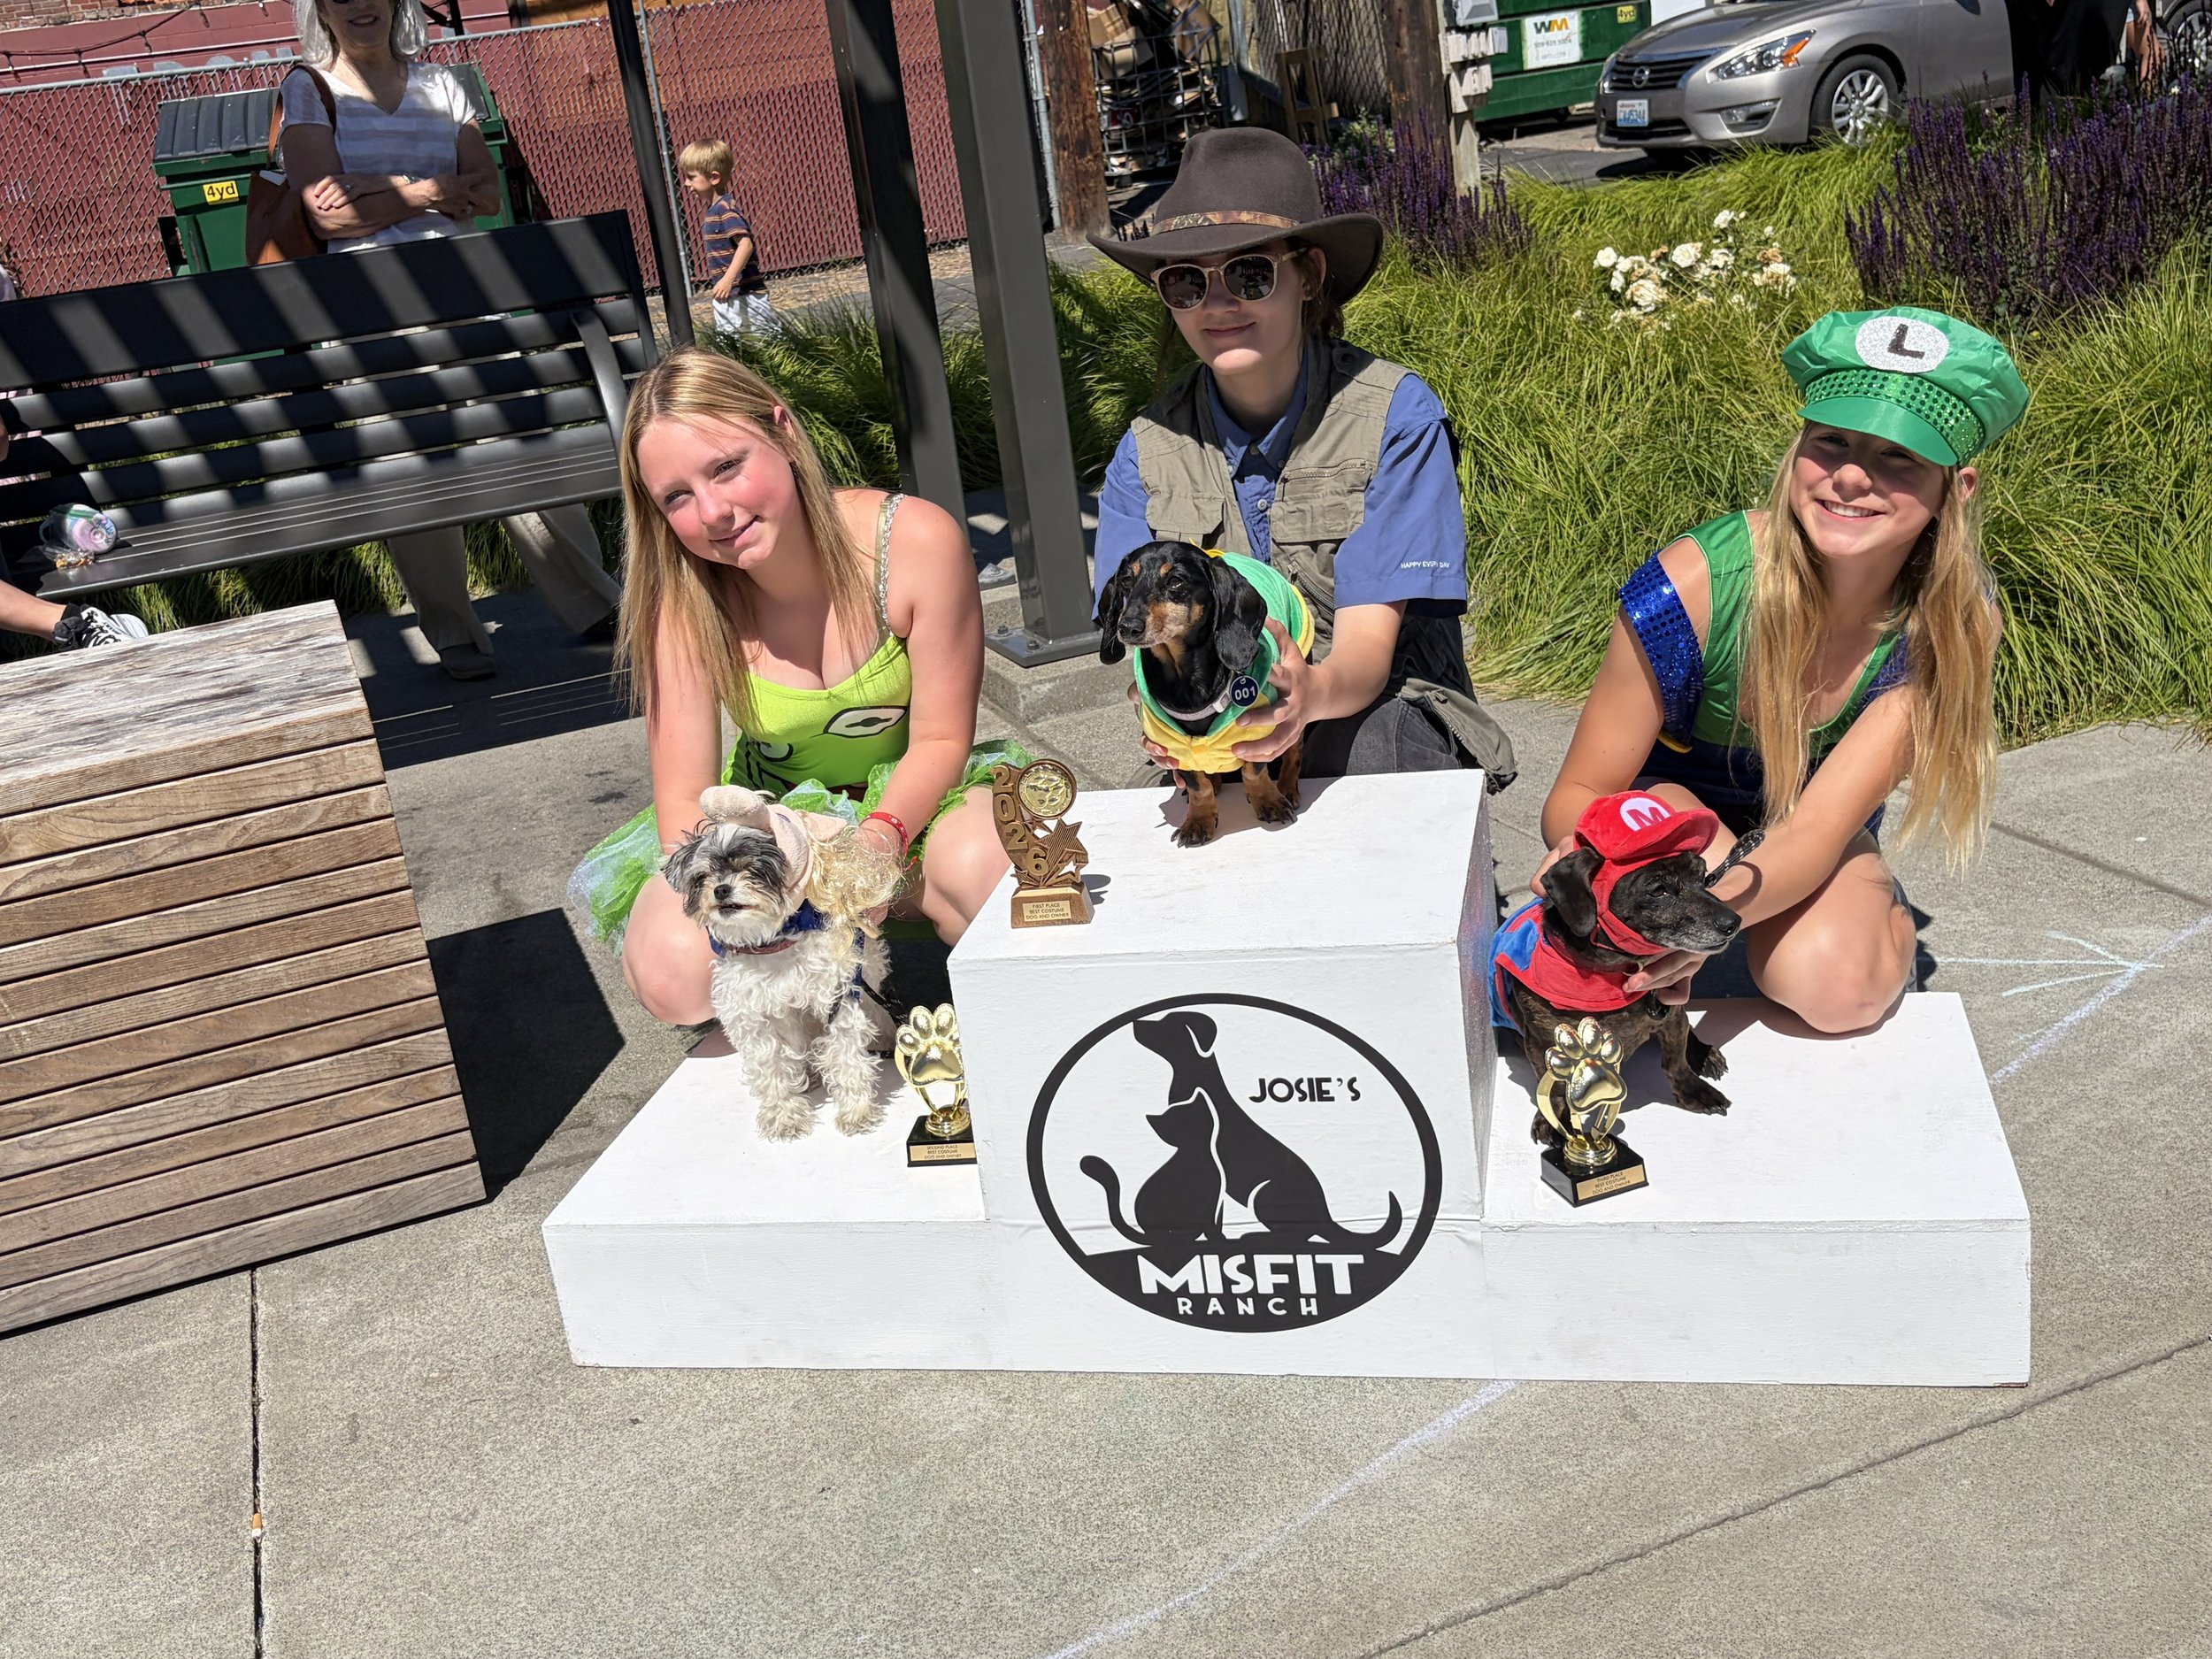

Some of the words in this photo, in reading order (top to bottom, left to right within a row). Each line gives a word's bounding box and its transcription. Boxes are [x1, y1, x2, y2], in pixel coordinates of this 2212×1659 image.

[1533, 18, 1570, 34] WM
[207, 182, 235, 200] 4yd
[1887, 323, 1925, 359] L
[1234, 687, 1256, 701] 001
[990, 764, 1049, 876] 2026
[1626, 806, 1665, 830] M
[1248, 1077, 1361, 1103] JOSIE'S
[1605, 1176, 1626, 1186] COSTUME
[1136, 1254, 1364, 1295] MISFIT
[1177, 1296, 1318, 1316] RANCH
